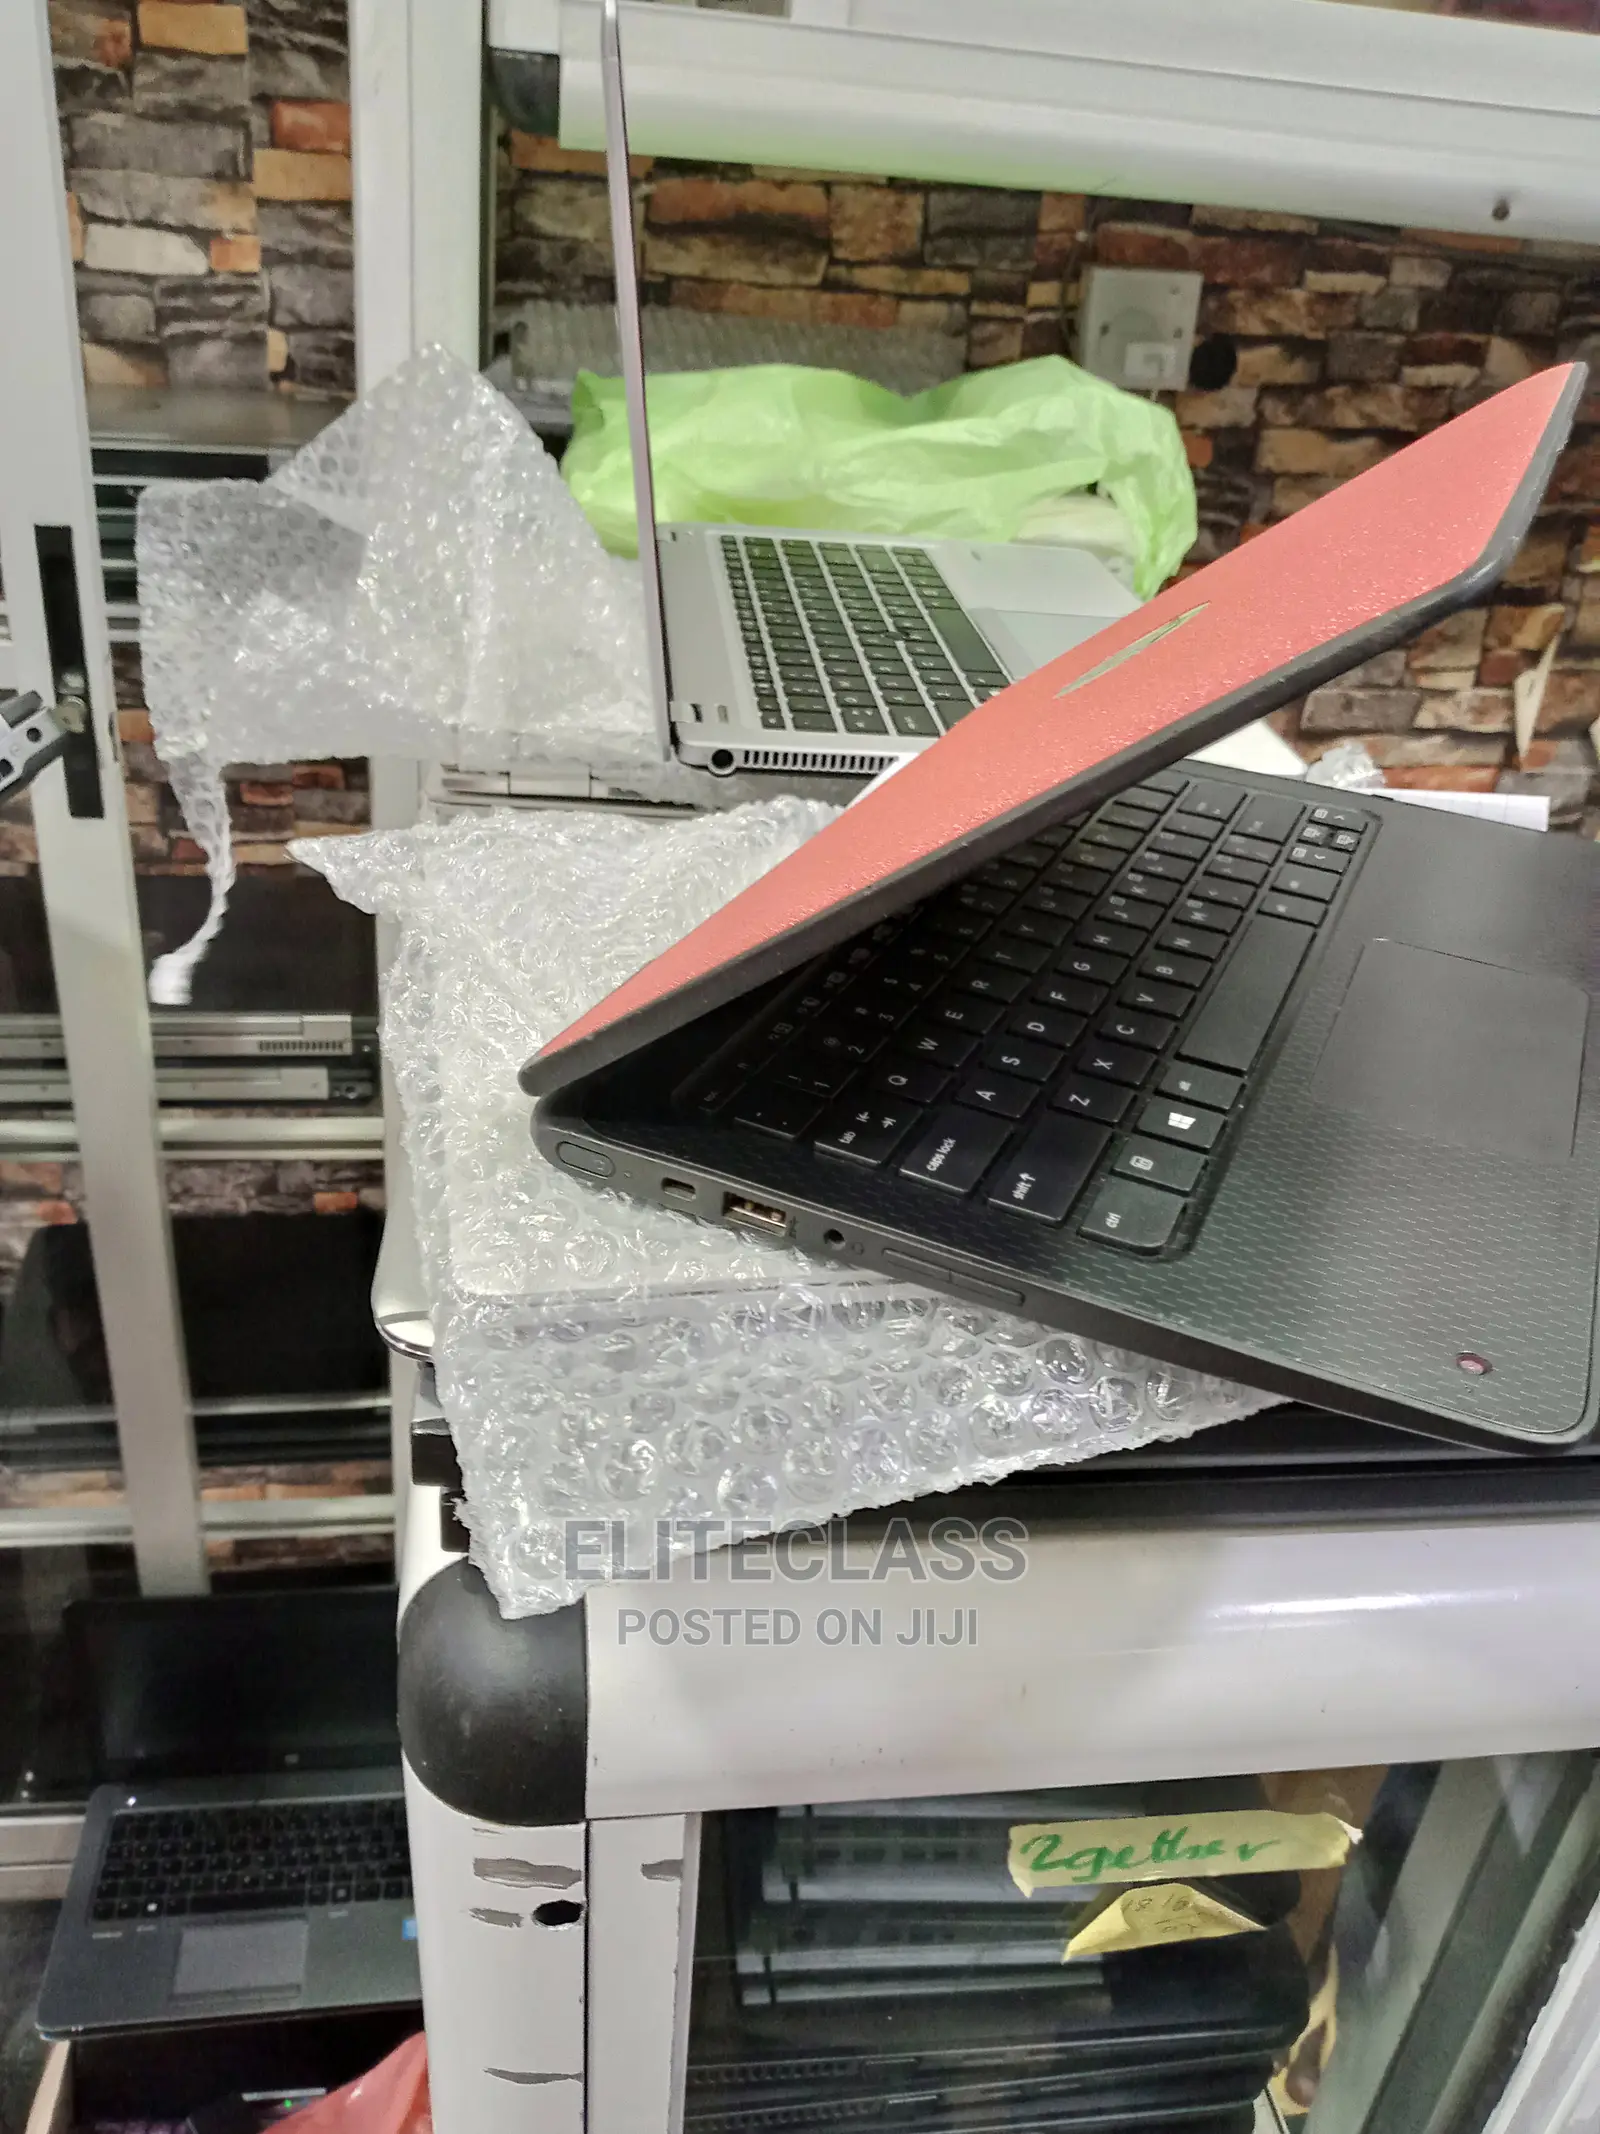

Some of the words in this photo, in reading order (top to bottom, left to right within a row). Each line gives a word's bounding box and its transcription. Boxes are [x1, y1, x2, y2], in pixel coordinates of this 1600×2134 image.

[1093, 934, 1111, 946] H
[1073, 961, 1091, 972] G
[1155, 965, 1174, 976] B
[971, 979, 990, 990] R
[1049, 990, 1067, 1002] F
[1136, 993, 1155, 1003] V
[944, 1009, 964, 1021] E
[1026, 1021, 1045, 1033] D
[1116, 1023, 1135, 1035] C
[917, 1037, 940, 1051] W
[1001, 1055, 1021, 1067] S
[1092, 1057, 1114, 1071] X
[888, 1074, 909, 1086] Q
[975, 1089, 997, 1101] A
[1068, 1093, 1091, 1107] Z
[838, 1131, 856, 1144] tab
[926, 1152, 945, 1172] caps
[936, 1137, 956, 1155] lock
[1012, 1181, 1032, 1200] shift
